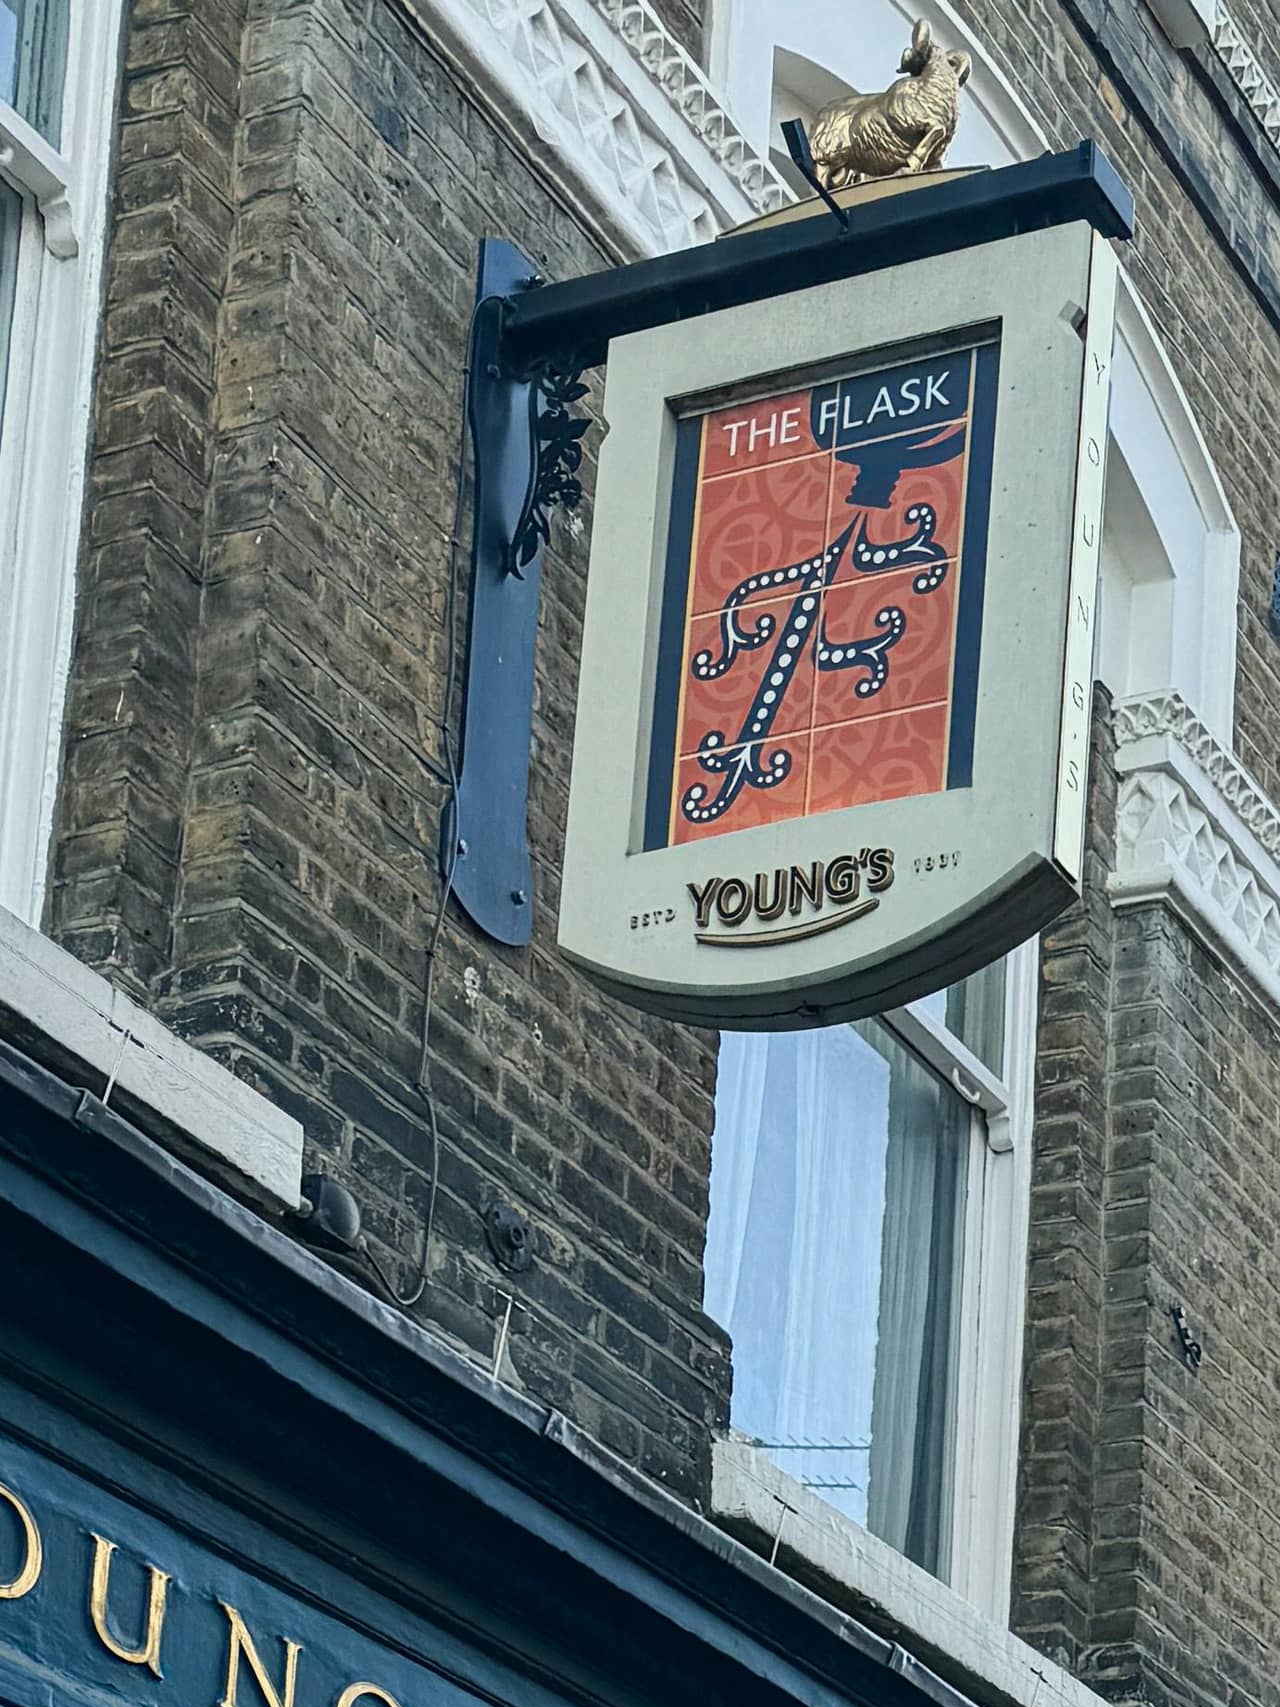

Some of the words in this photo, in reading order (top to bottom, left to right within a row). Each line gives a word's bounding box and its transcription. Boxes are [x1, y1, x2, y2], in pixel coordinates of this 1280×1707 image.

[723, 407, 801, 457] THE
[818, 371, 950, 435] FLASK
[686, 847, 894, 927] YOUNG'S
